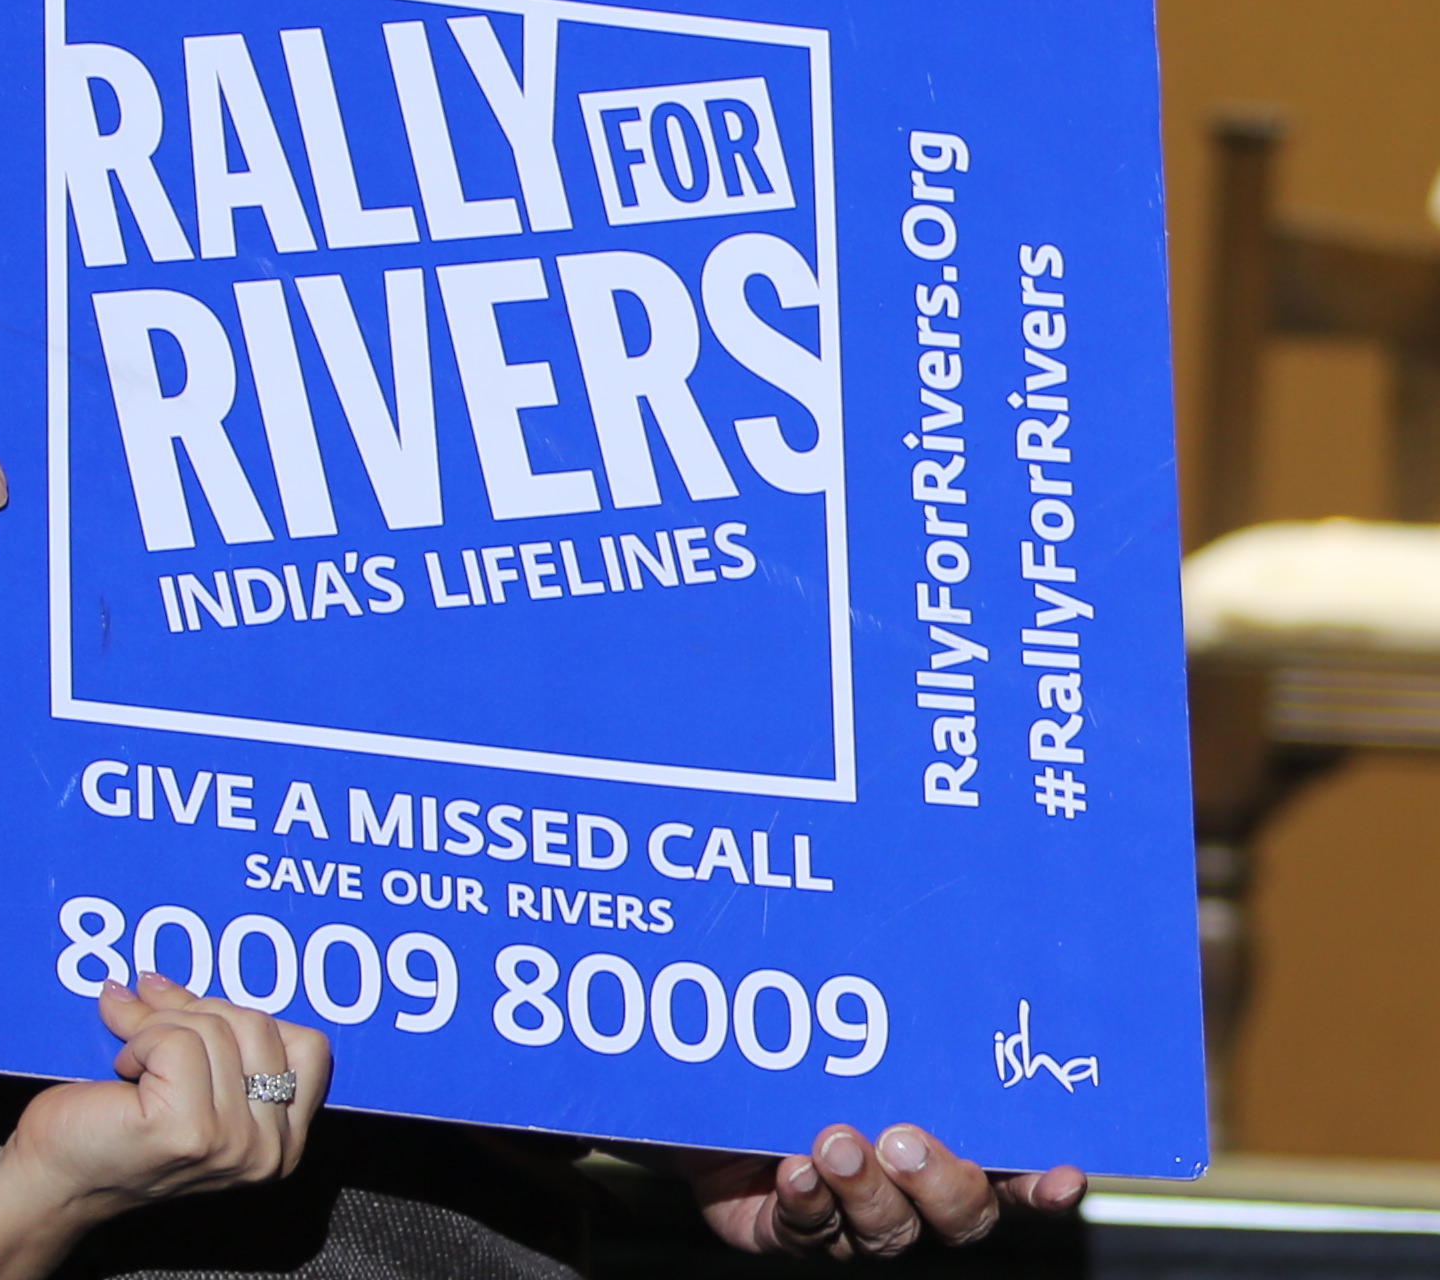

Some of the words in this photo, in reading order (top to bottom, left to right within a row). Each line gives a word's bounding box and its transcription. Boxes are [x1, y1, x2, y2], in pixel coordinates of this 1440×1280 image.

[63, 12, 574, 269] RALLY
[598, 97, 775, 210] FOR
[90, 232, 836, 552] RIVERS
[900, 129, 990, 808] RallyForRivers.Org
[158, 551, 405, 633] INDIA'S
[424, 522, 756, 609] LIFELINES
[1006, 243, 1095, 820] #RallyForRivers
[80, 759, 258, 832] GIVE
[273, 780, 330, 840] A
[348, 787, 629, 872] MISSED
[647, 821, 835, 893] CALL
[244, 852, 364, 901] SAVE
[381, 868, 490, 916] OUR
[506, 882, 675, 935] RIVERS
[55, 895, 459, 1034] 80009
[492, 943, 890, 1078] 80009
[993, 998, 1100, 1094] isha
